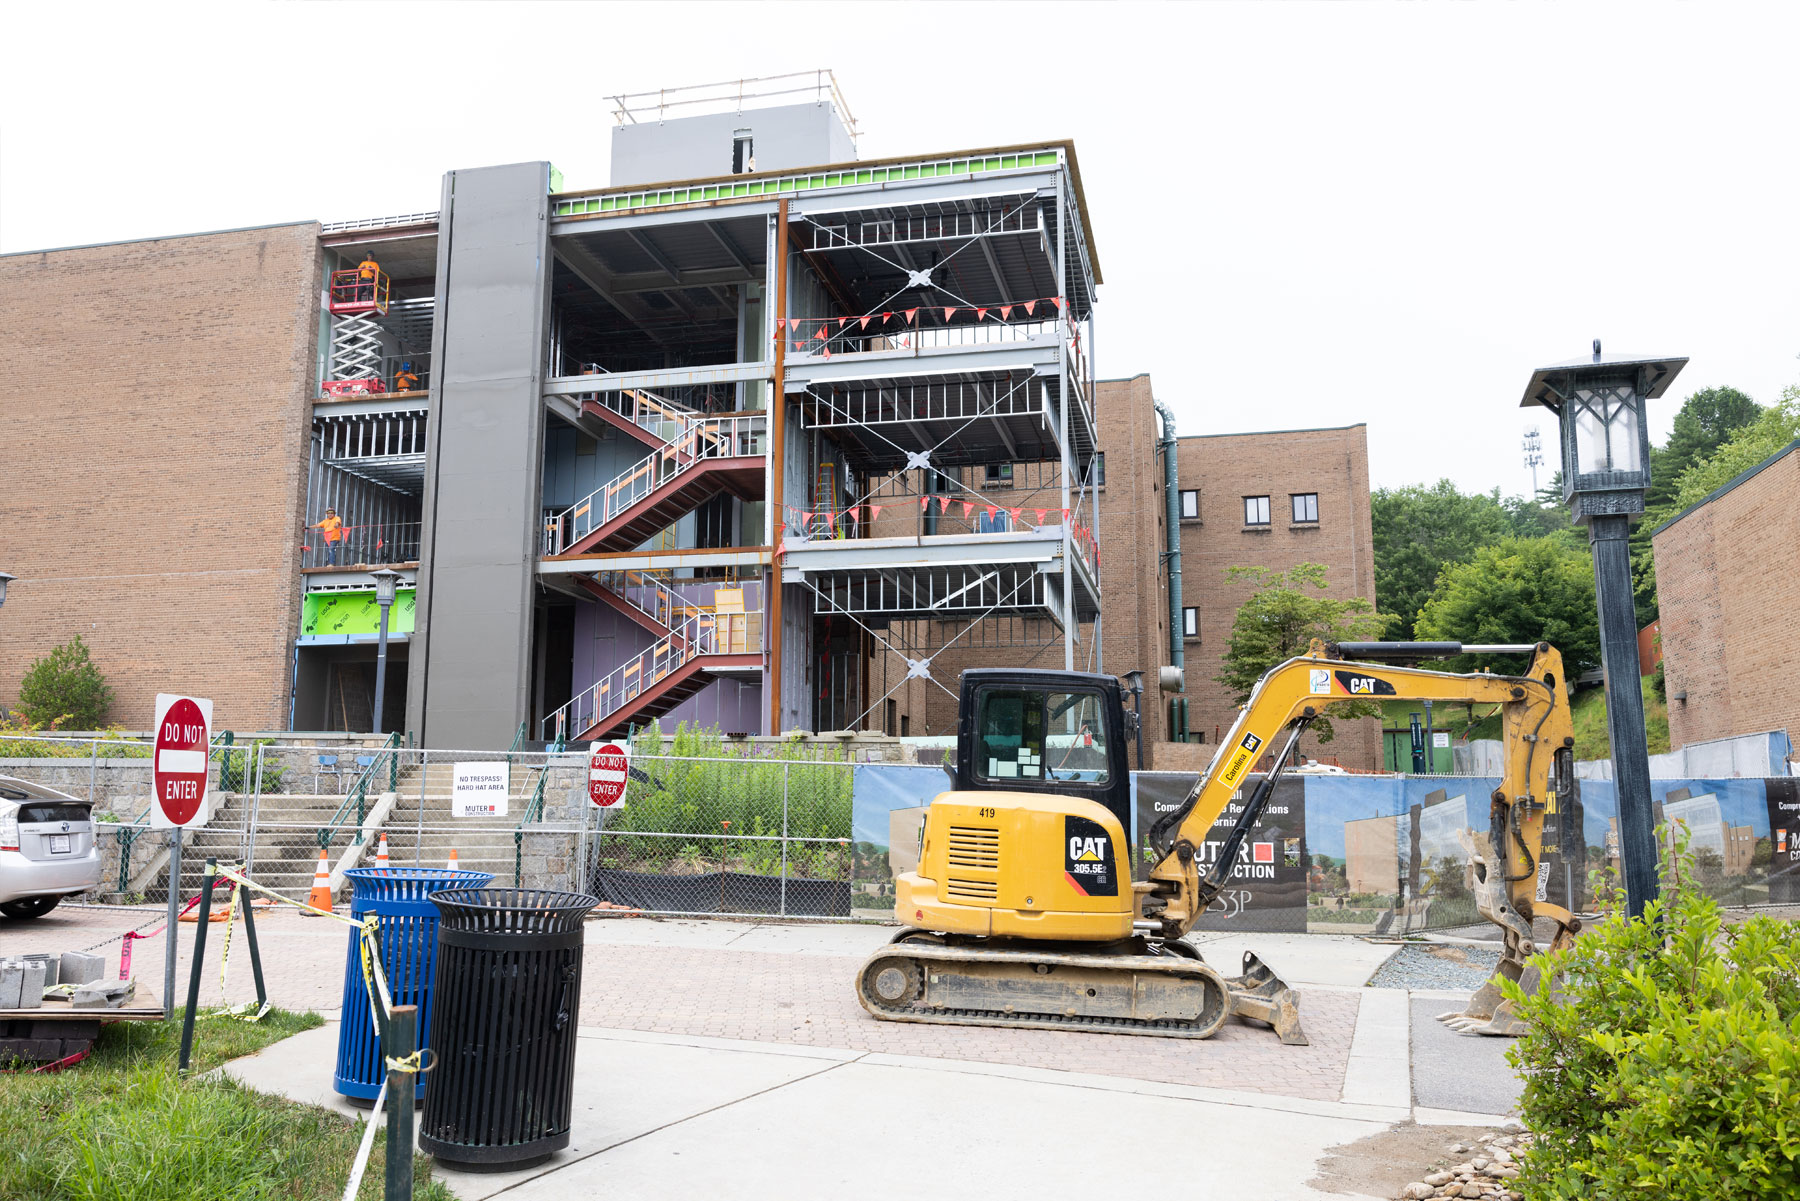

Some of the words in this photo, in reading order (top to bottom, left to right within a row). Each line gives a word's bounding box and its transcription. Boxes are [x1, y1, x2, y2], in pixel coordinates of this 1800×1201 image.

[1350, 678, 1376, 694] CAT
[165, 722, 180, 743] DO
[184, 724, 204, 744] NOT
[594, 756, 606, 766] DO
[608, 757, 625, 768] NOT
[1225, 753, 1247, 781] Carolina
[1244, 735, 1257, 750] CAT
[166, 780, 198, 800] ENTER
[594, 784, 618, 795] ENTER
[979, 808, 996, 818] 419
[1069, 836, 1107, 861] CAT
